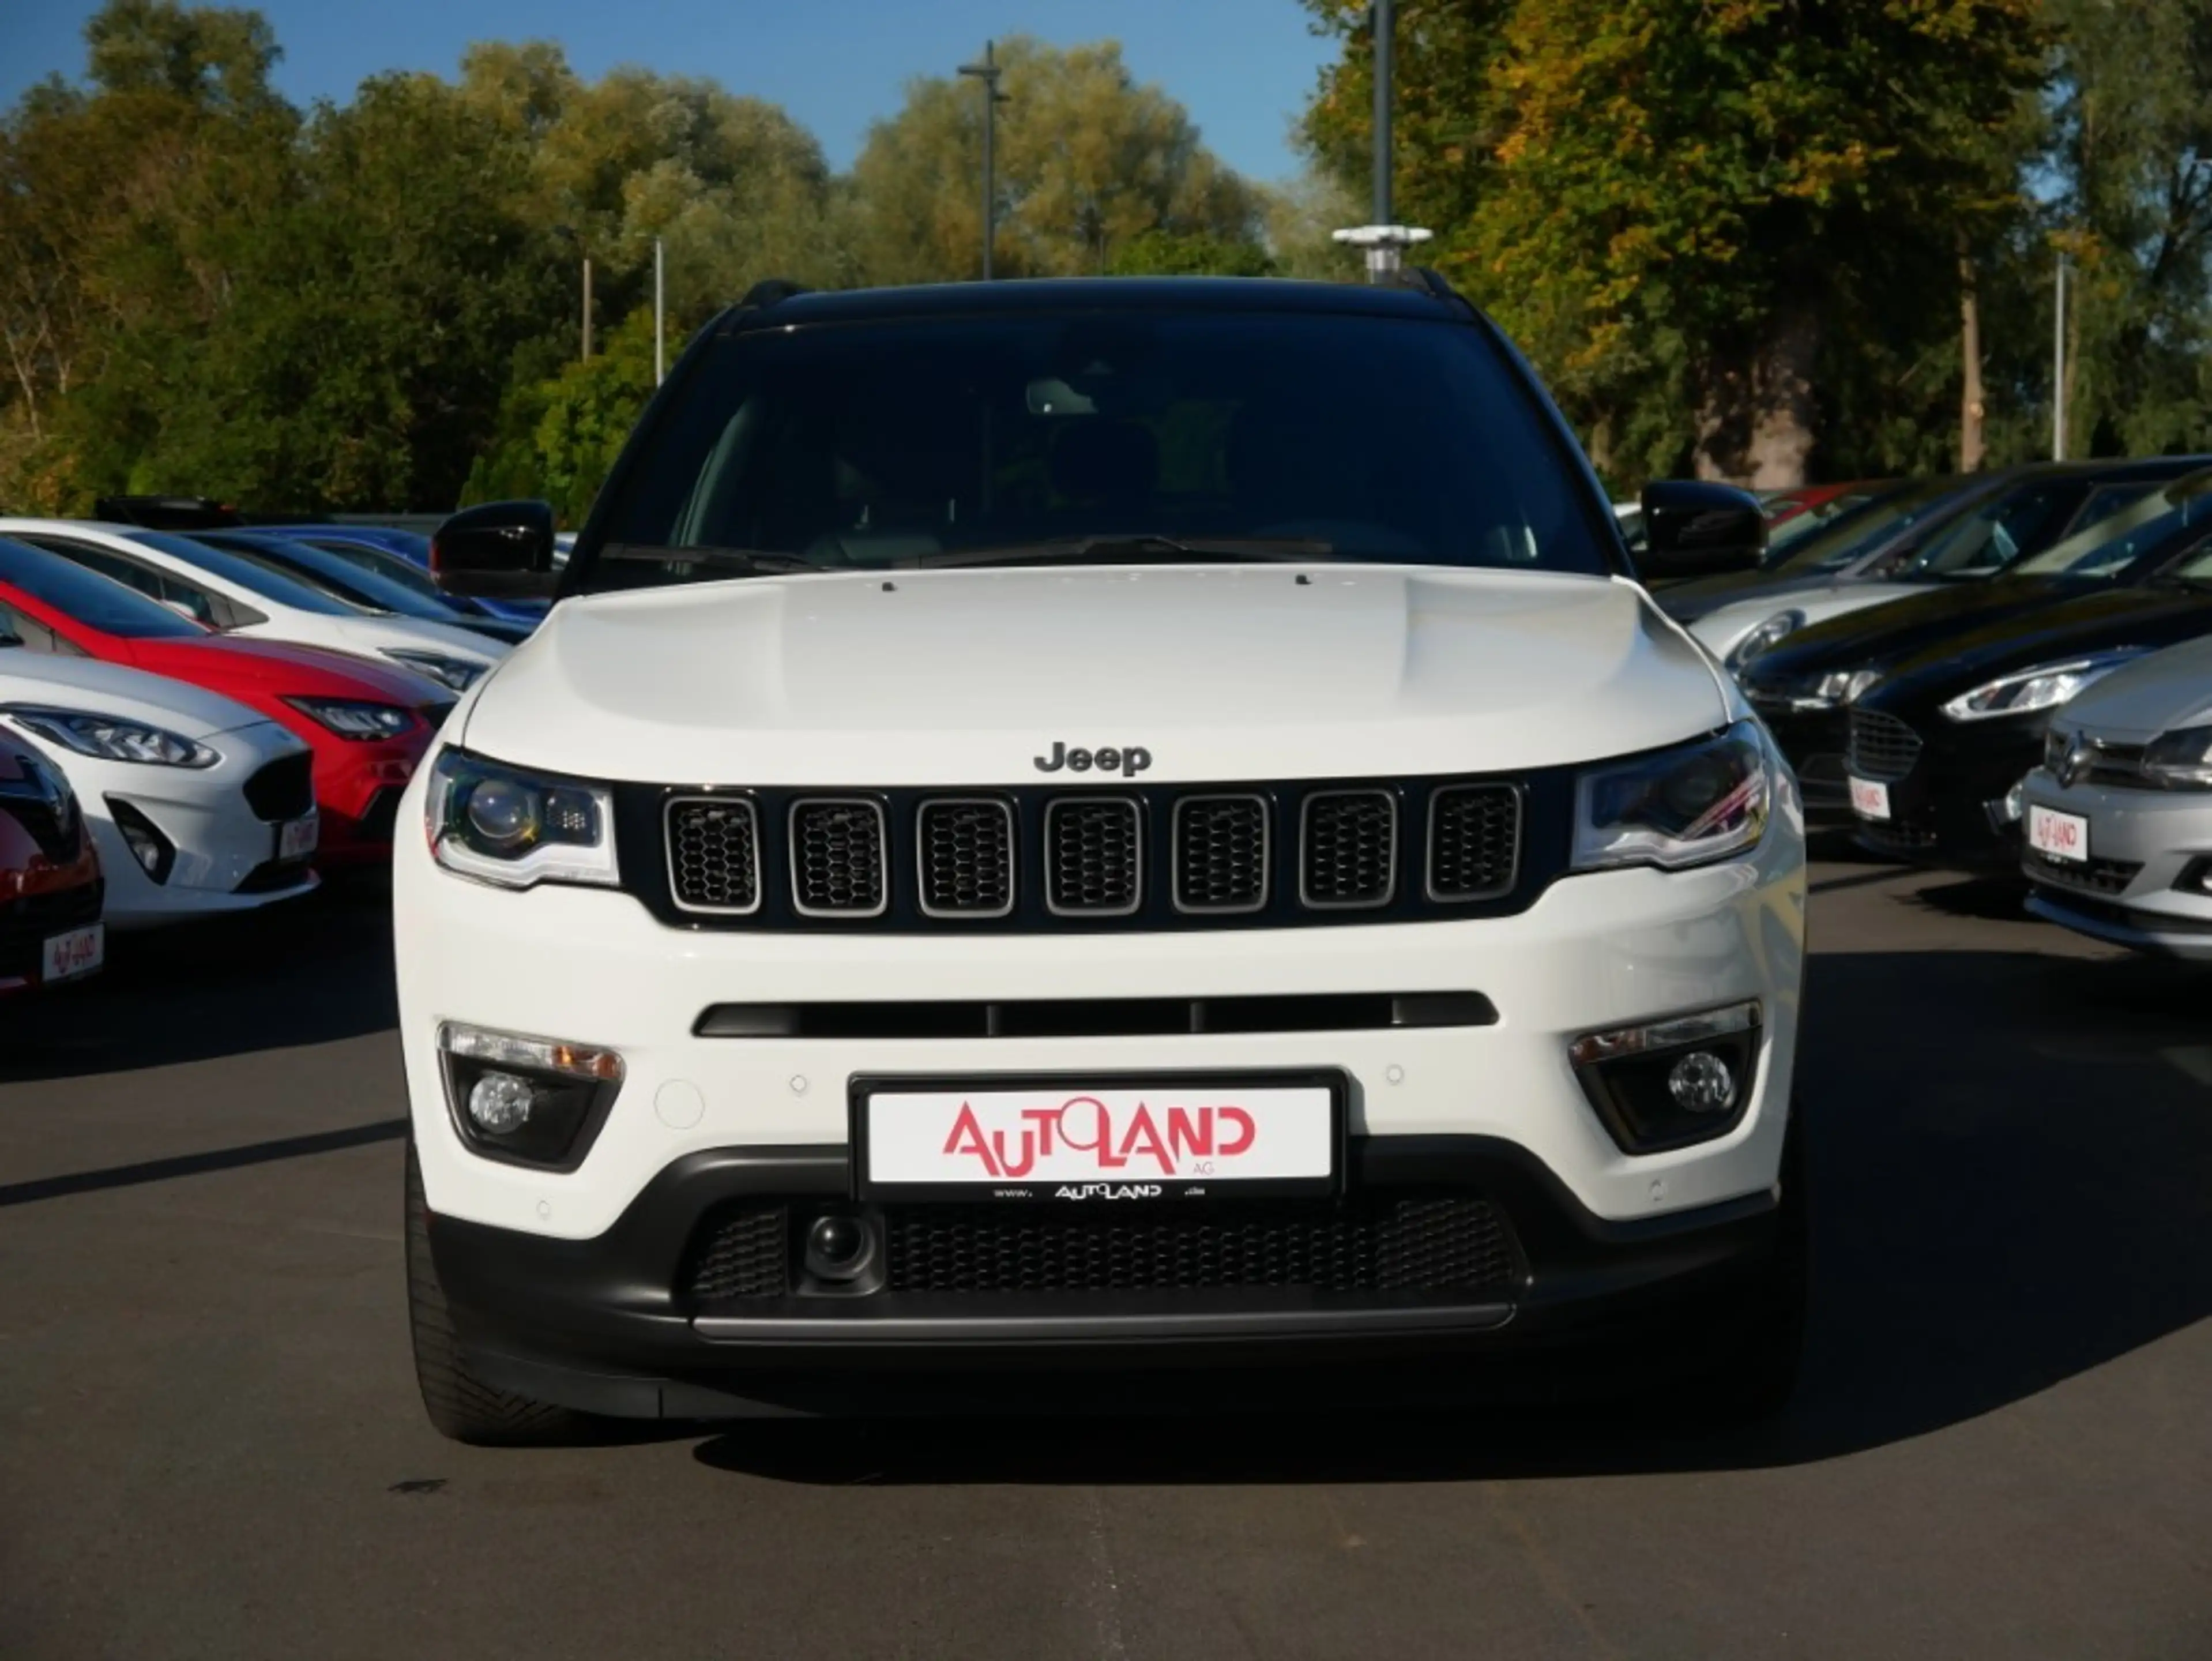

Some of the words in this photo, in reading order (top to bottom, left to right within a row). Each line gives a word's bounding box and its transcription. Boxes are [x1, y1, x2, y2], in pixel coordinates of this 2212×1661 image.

[1034, 742, 1152, 777] Jeep
[942, 1096, 1257, 1178] AUTOLAND
[1192, 1161, 1215, 1175] AG
[1054, 1183, 1163, 1201] AUTOLAND
